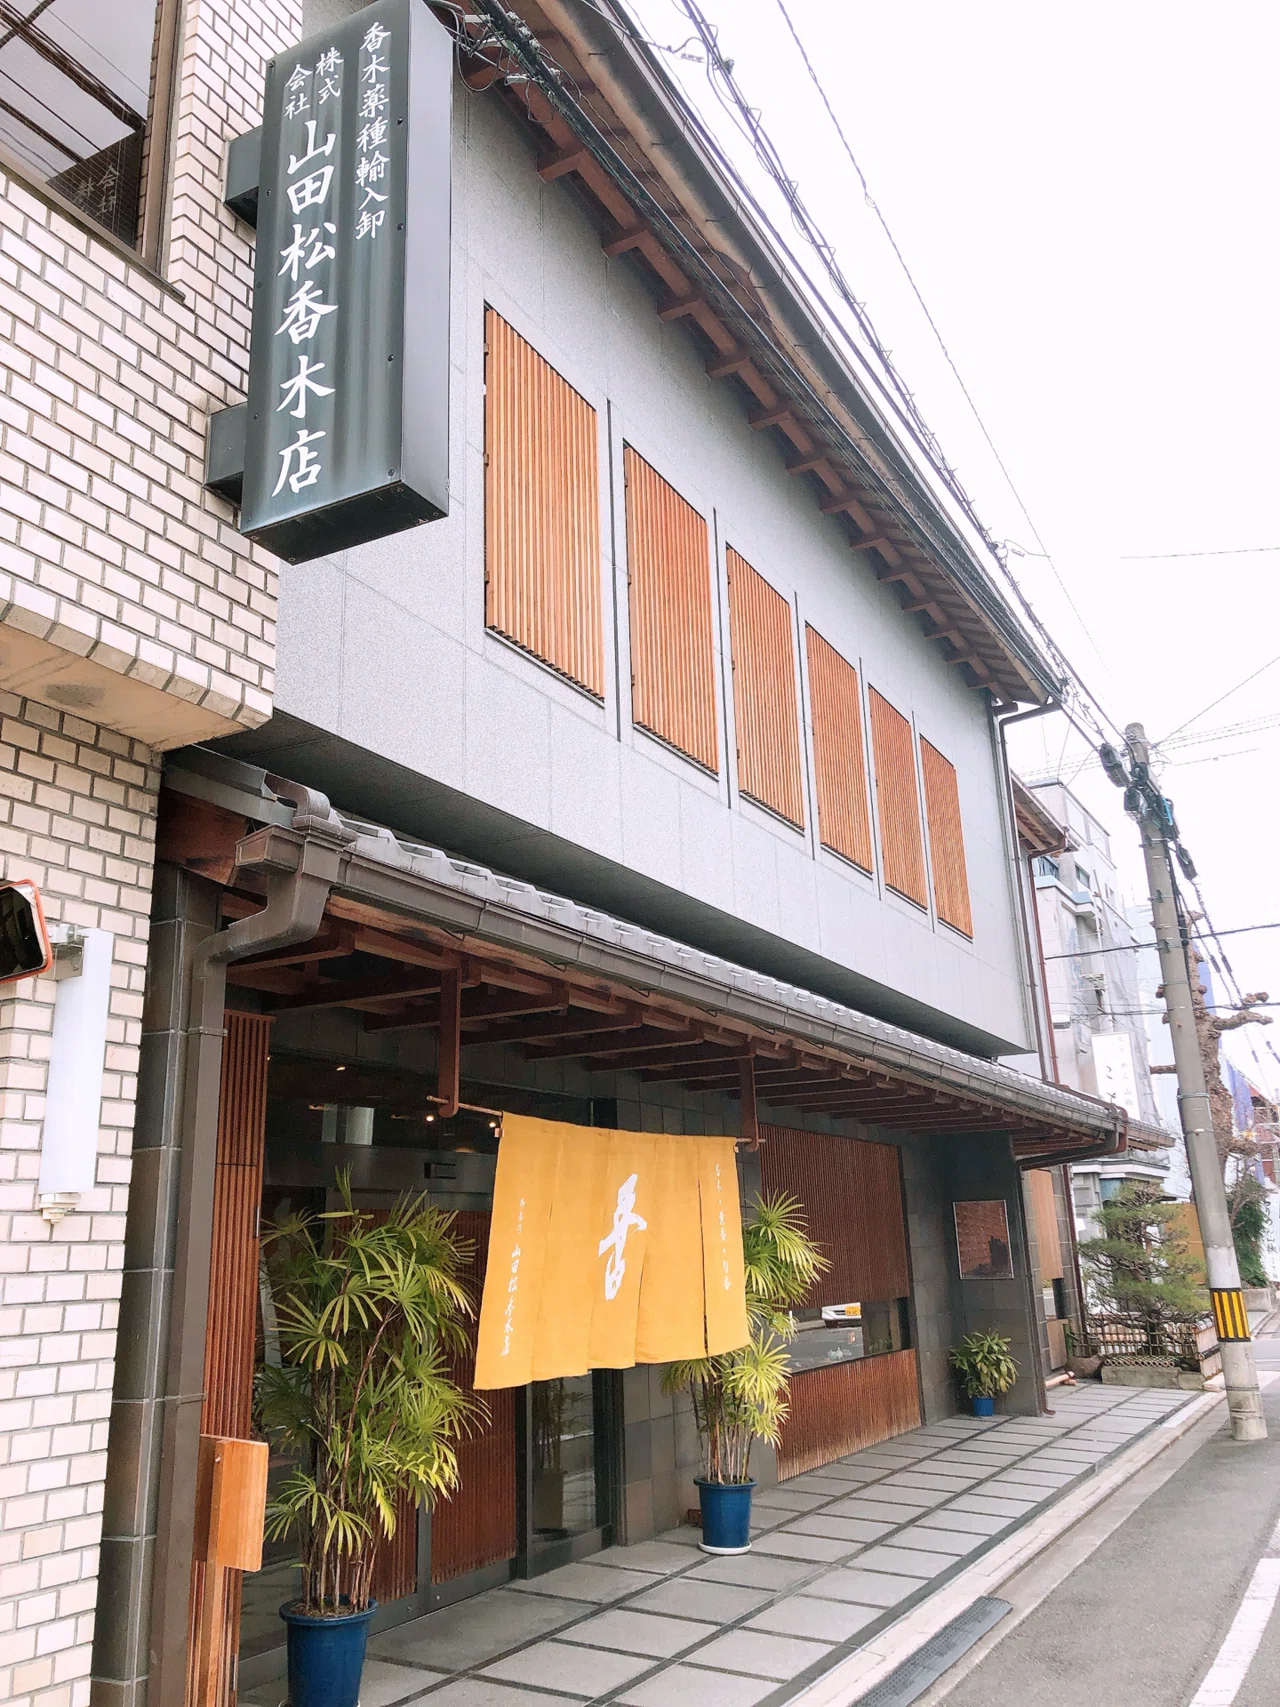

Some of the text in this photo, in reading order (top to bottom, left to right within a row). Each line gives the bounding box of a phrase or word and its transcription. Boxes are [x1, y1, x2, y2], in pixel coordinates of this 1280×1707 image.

[283, 63, 313, 121] 会社
[315, 46, 344, 105] 株式
[355, 21, 392, 240] 香木薬種輸入卸
[271, 119, 339, 498] 山田松香木店
